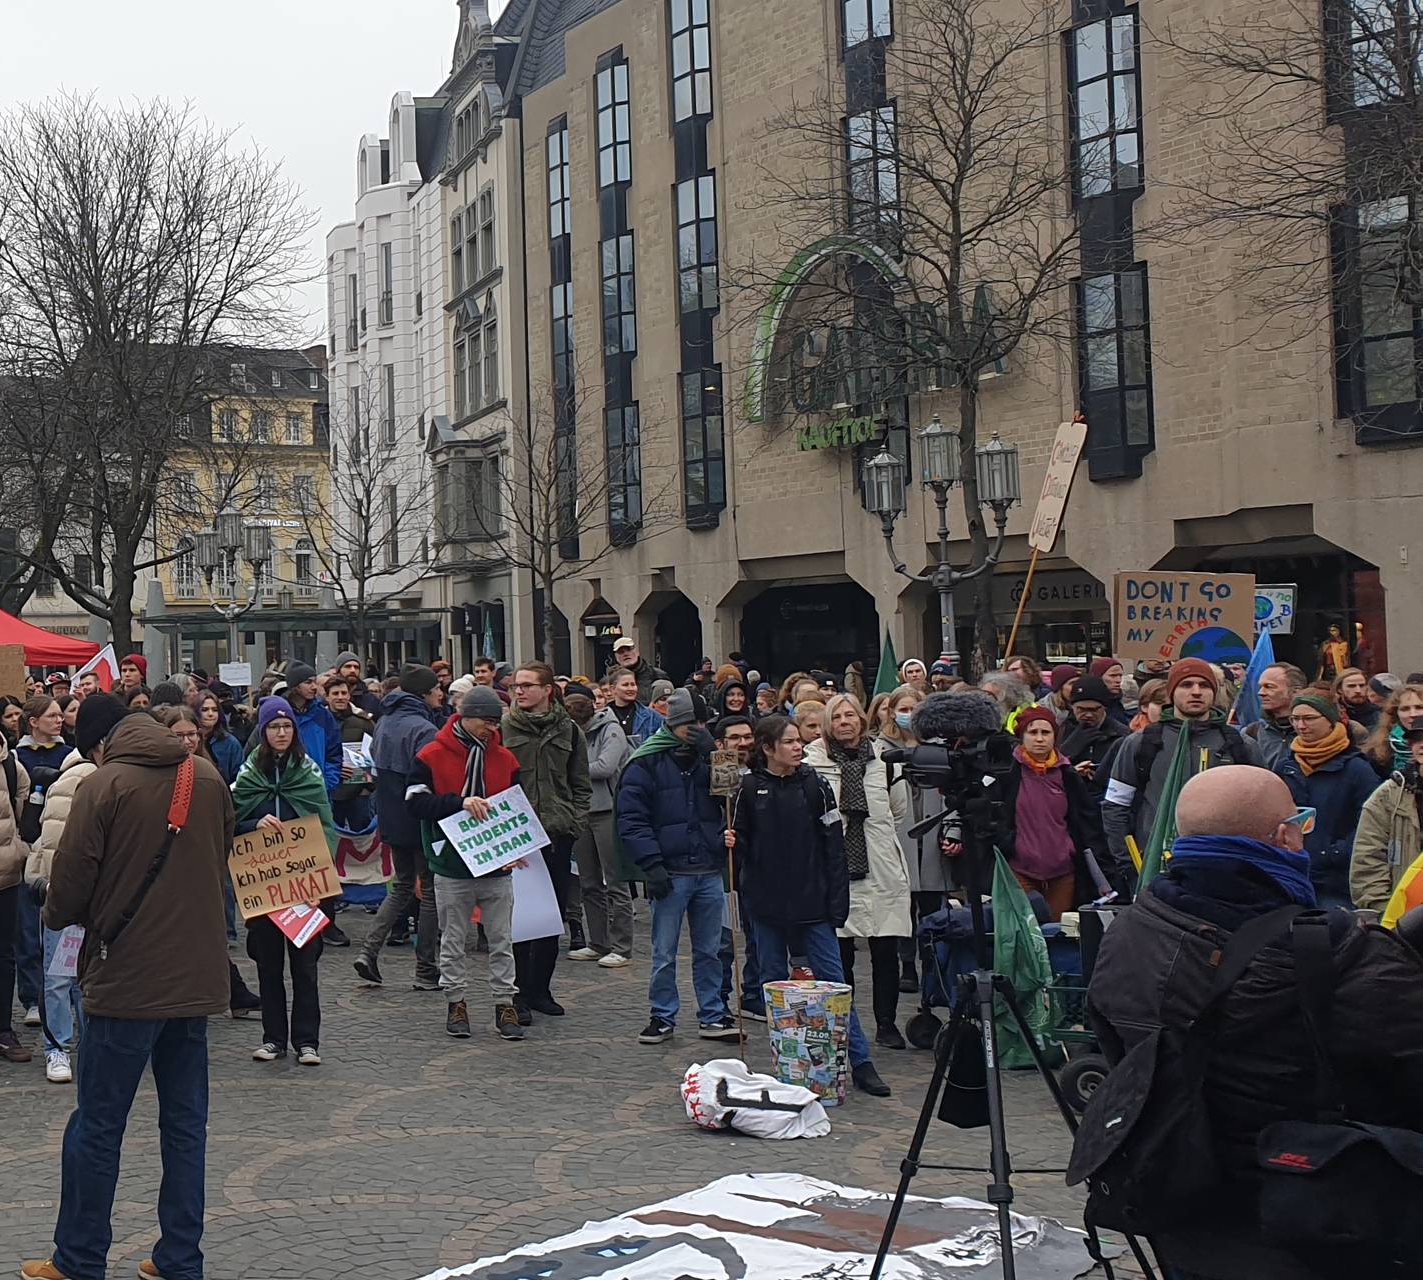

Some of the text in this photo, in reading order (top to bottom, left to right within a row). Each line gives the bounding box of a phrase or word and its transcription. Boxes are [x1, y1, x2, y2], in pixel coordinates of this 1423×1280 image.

[1038, 583, 1105, 601] GALERI
[1127, 579, 1231, 603] DON'T GO
[1127, 605, 1224, 622] BREAKING
[1127, 628, 1155, 642] MY
[1158, 617, 1209, 658] EARTH
[457, 801, 511, 832] BON 4
[262, 831, 285, 848] bin
[457, 812, 529, 852] STUDENTS
[473, 831, 533, 865] IN IRAN
[258, 865, 282, 882] hab
[243, 866, 330, 909] ein PLAKAT
[806, 1030, 830, 1040] 23.09.
